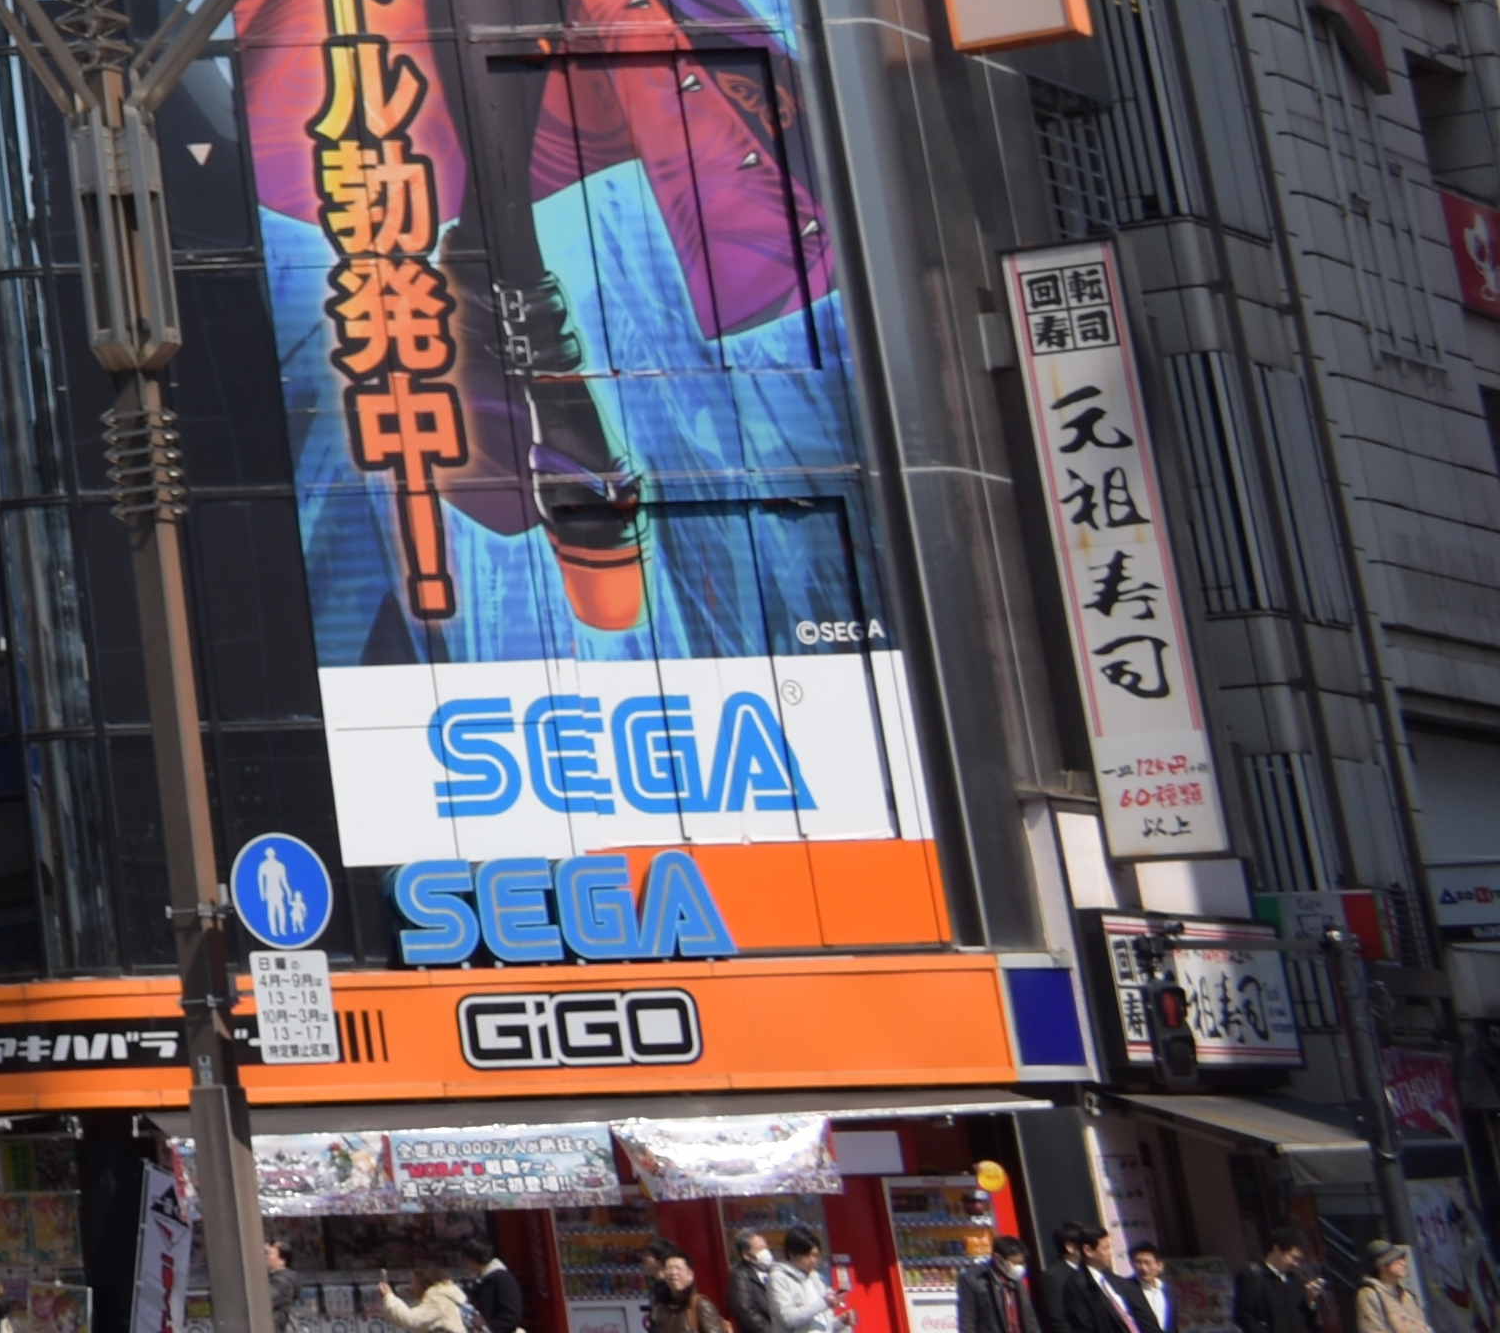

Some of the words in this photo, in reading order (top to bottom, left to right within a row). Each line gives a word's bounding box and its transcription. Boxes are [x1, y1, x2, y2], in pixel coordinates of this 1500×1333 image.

[1047, 385, 1176, 701] 元祖寿司
[425, 690, 819, 820] SEGA
[1141, 813, 1194, 838] 以上
[392, 850, 739, 965] SEGA
[457, 987, 704, 1070] GiGO
